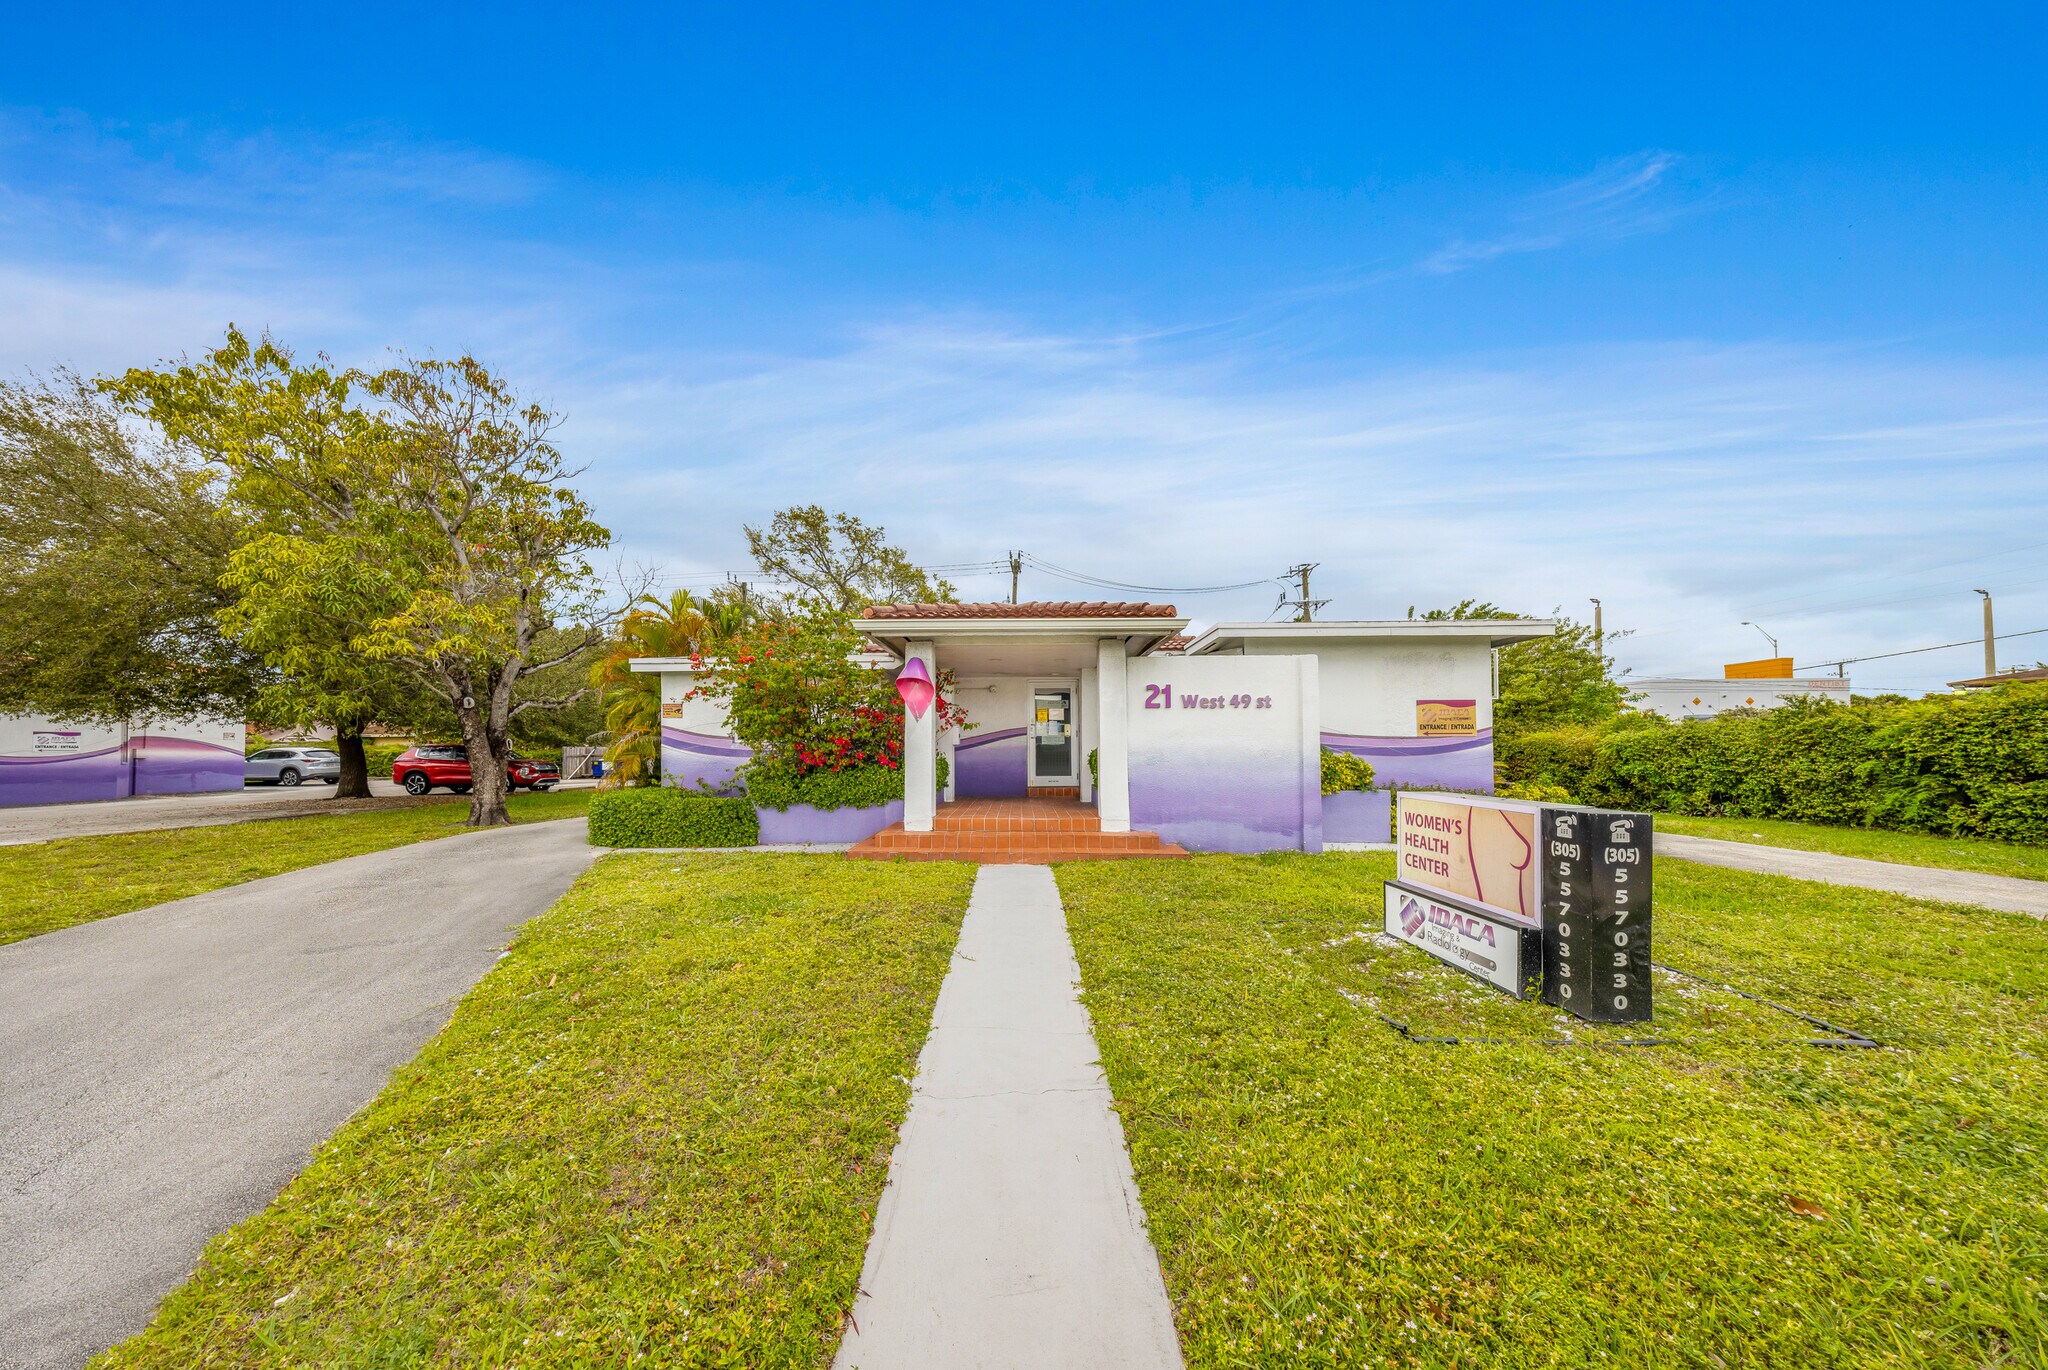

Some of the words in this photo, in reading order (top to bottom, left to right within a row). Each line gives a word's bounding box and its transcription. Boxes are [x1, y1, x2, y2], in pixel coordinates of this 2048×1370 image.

[1145, 684, 1172, 709] 21
[1181, 694, 1225, 709] West
[1230, 694, 1252, 709] 49
[1256, 695, 1272, 709] st
[1404, 811, 1462, 835] WOMEN'S
[1405, 832, 1449, 855] HEALTH
[1551, 841, 1580, 861] (305)
[1405, 853, 1449, 878] CENTER
[1604, 848, 1640, 864] (305)
[1428, 904, 1496, 949] IDACA
[1431, 923, 1456, 942] Imaging
[1427, 930, 1470, 961] Radiology
[1469, 962, 1490, 976] Center
